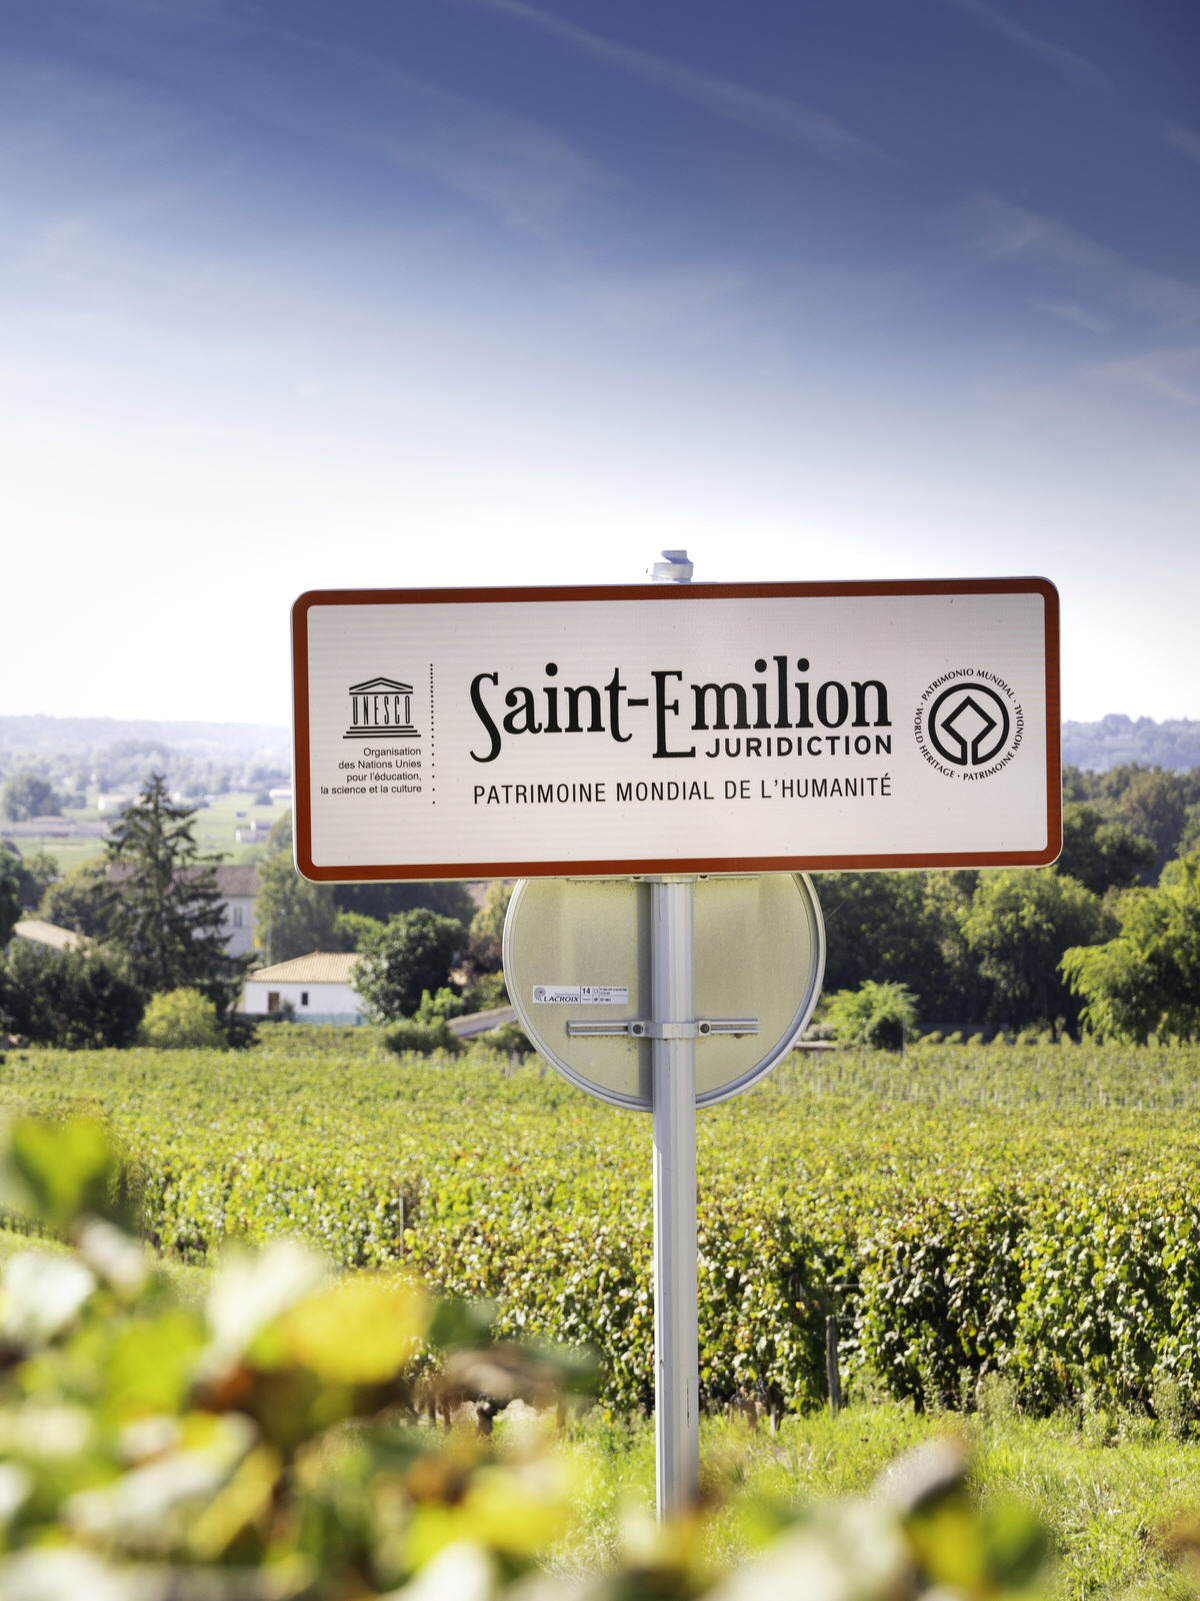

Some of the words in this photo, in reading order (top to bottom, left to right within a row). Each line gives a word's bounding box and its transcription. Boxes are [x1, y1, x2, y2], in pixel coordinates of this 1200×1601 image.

[921, 668, 974, 701] PATRIMONIO
[976, 669, 1015, 699] MUNDIAL
[352, 695, 411, 725] UNESCO
[469, 655, 892, 763] Saint-Emilion
[363, 747, 422, 758] Organisation
[705, 734, 892, 758] JURIDICTION
[913, 707, 924, 744] WORLD
[919, 744, 956, 779] HERITAGE
[963, 750, 1016, 781] PATRIMOINE
[1010, 703, 1025, 752] MONDIAL
[338, 760, 355, 769] des
[357, 760, 393, 769] Nations
[395, 759, 422, 768] Unies
[320, 785, 329, 795] la
[331, 785, 367, 795] science
[369, 785, 378, 794] et
[380, 784, 389, 794] la
[391, 783, 422, 793] culture
[346, 774, 367, 783] pour
[369, 771, 422, 782] l'éducation,
[473, 782, 606, 805] PATRIMOINE
[616, 780, 715, 802] MONDIAL
[724, 779, 751, 800] DE
[761, 772, 892, 799] L'HUMANITÉ
[543, 995, 579, 1003] LACROIX
[582, 987, 591, 995] 14
